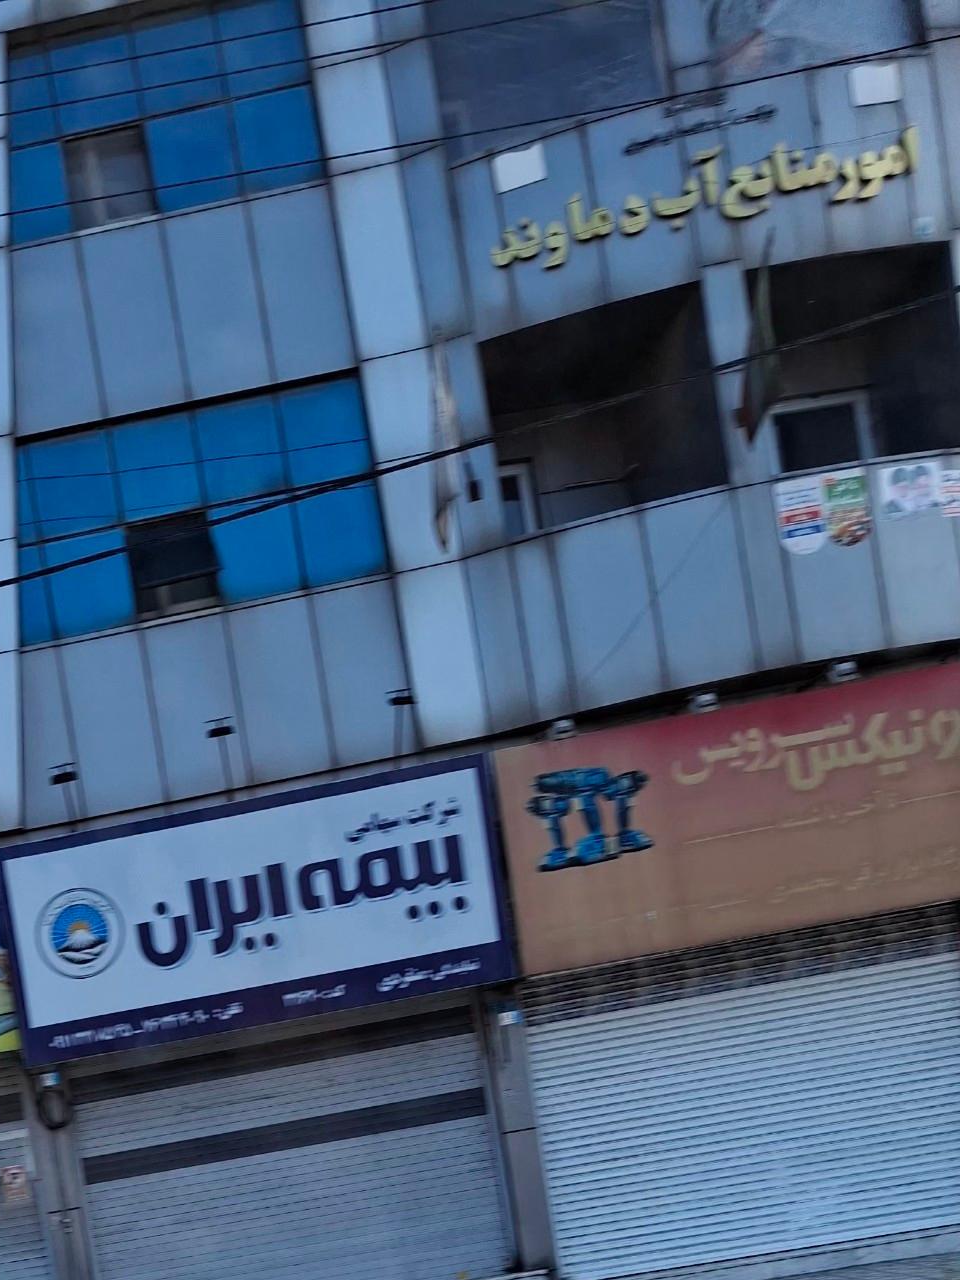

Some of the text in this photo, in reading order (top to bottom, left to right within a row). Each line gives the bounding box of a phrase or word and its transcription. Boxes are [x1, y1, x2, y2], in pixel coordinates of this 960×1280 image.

[652, 144, 724, 231] آب
[720, 141, 838, 220] منابع
[830, 127, 921, 202] امور
[488, 192, 650, 269] دماوند
[135, 834, 469, 969] بیمه ایران
